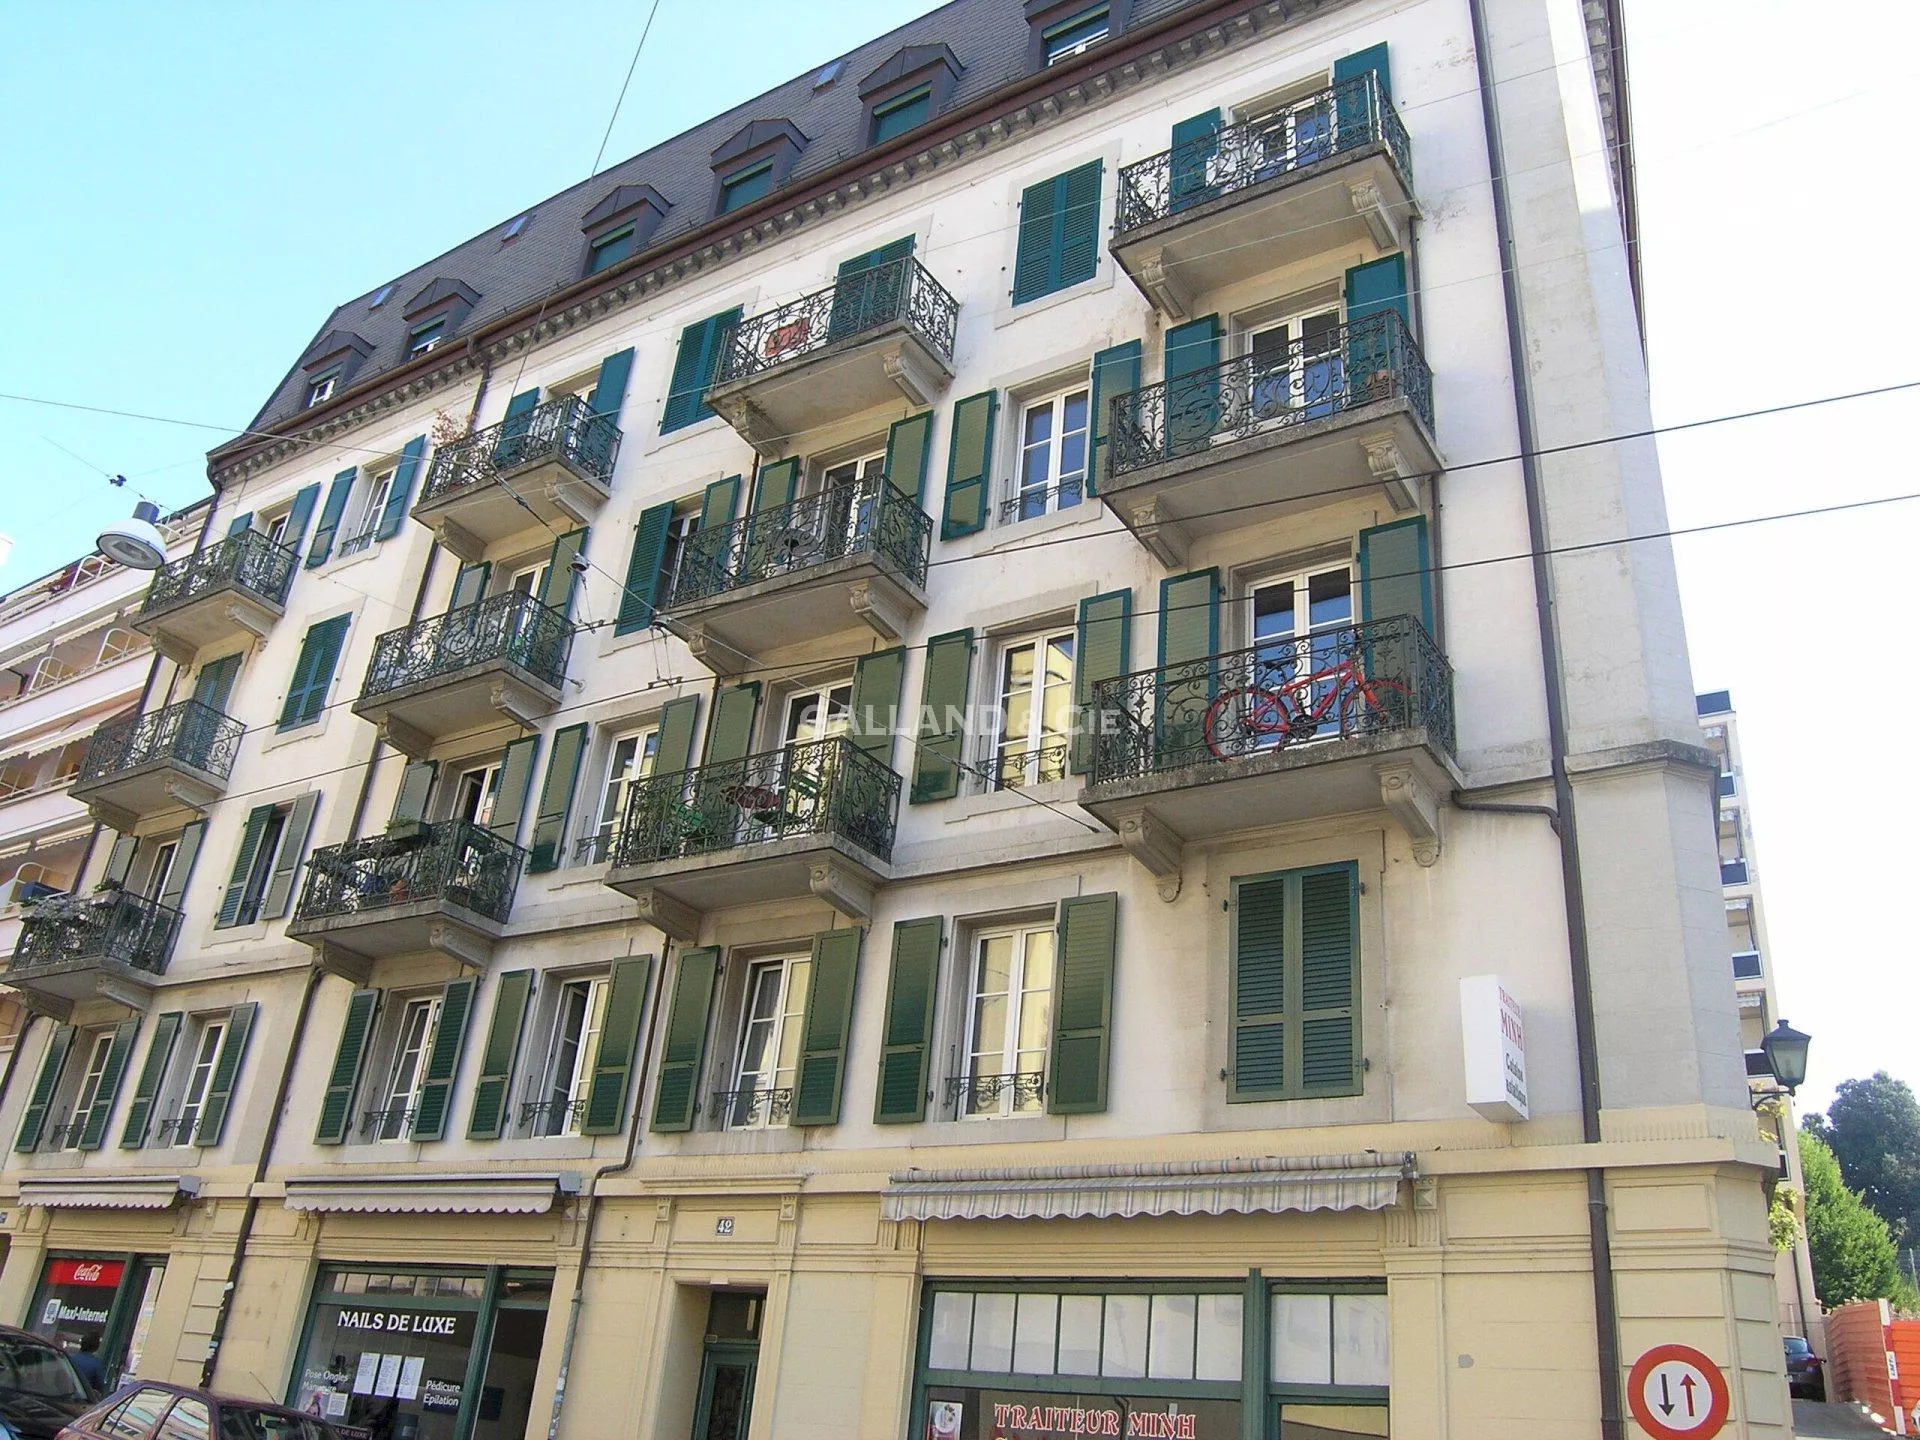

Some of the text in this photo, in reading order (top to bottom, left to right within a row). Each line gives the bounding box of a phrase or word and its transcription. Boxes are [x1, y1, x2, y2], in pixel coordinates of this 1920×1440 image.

[1500, 1008, 1523, 1051] MINH
[718, 1219, 733, 1233] 42
[58, 1306, 108, 1322] Maxi-Internet
[338, 1311, 456, 1334] NAILS DE LUXE
[305, 1369, 349, 1384] Pose Ongles
[426, 1380, 460, 1393] Pédicure
[423, 1394, 459, 1406] Epilation
[994, 1403, 1197, 1439] TRAITEUR MINH
